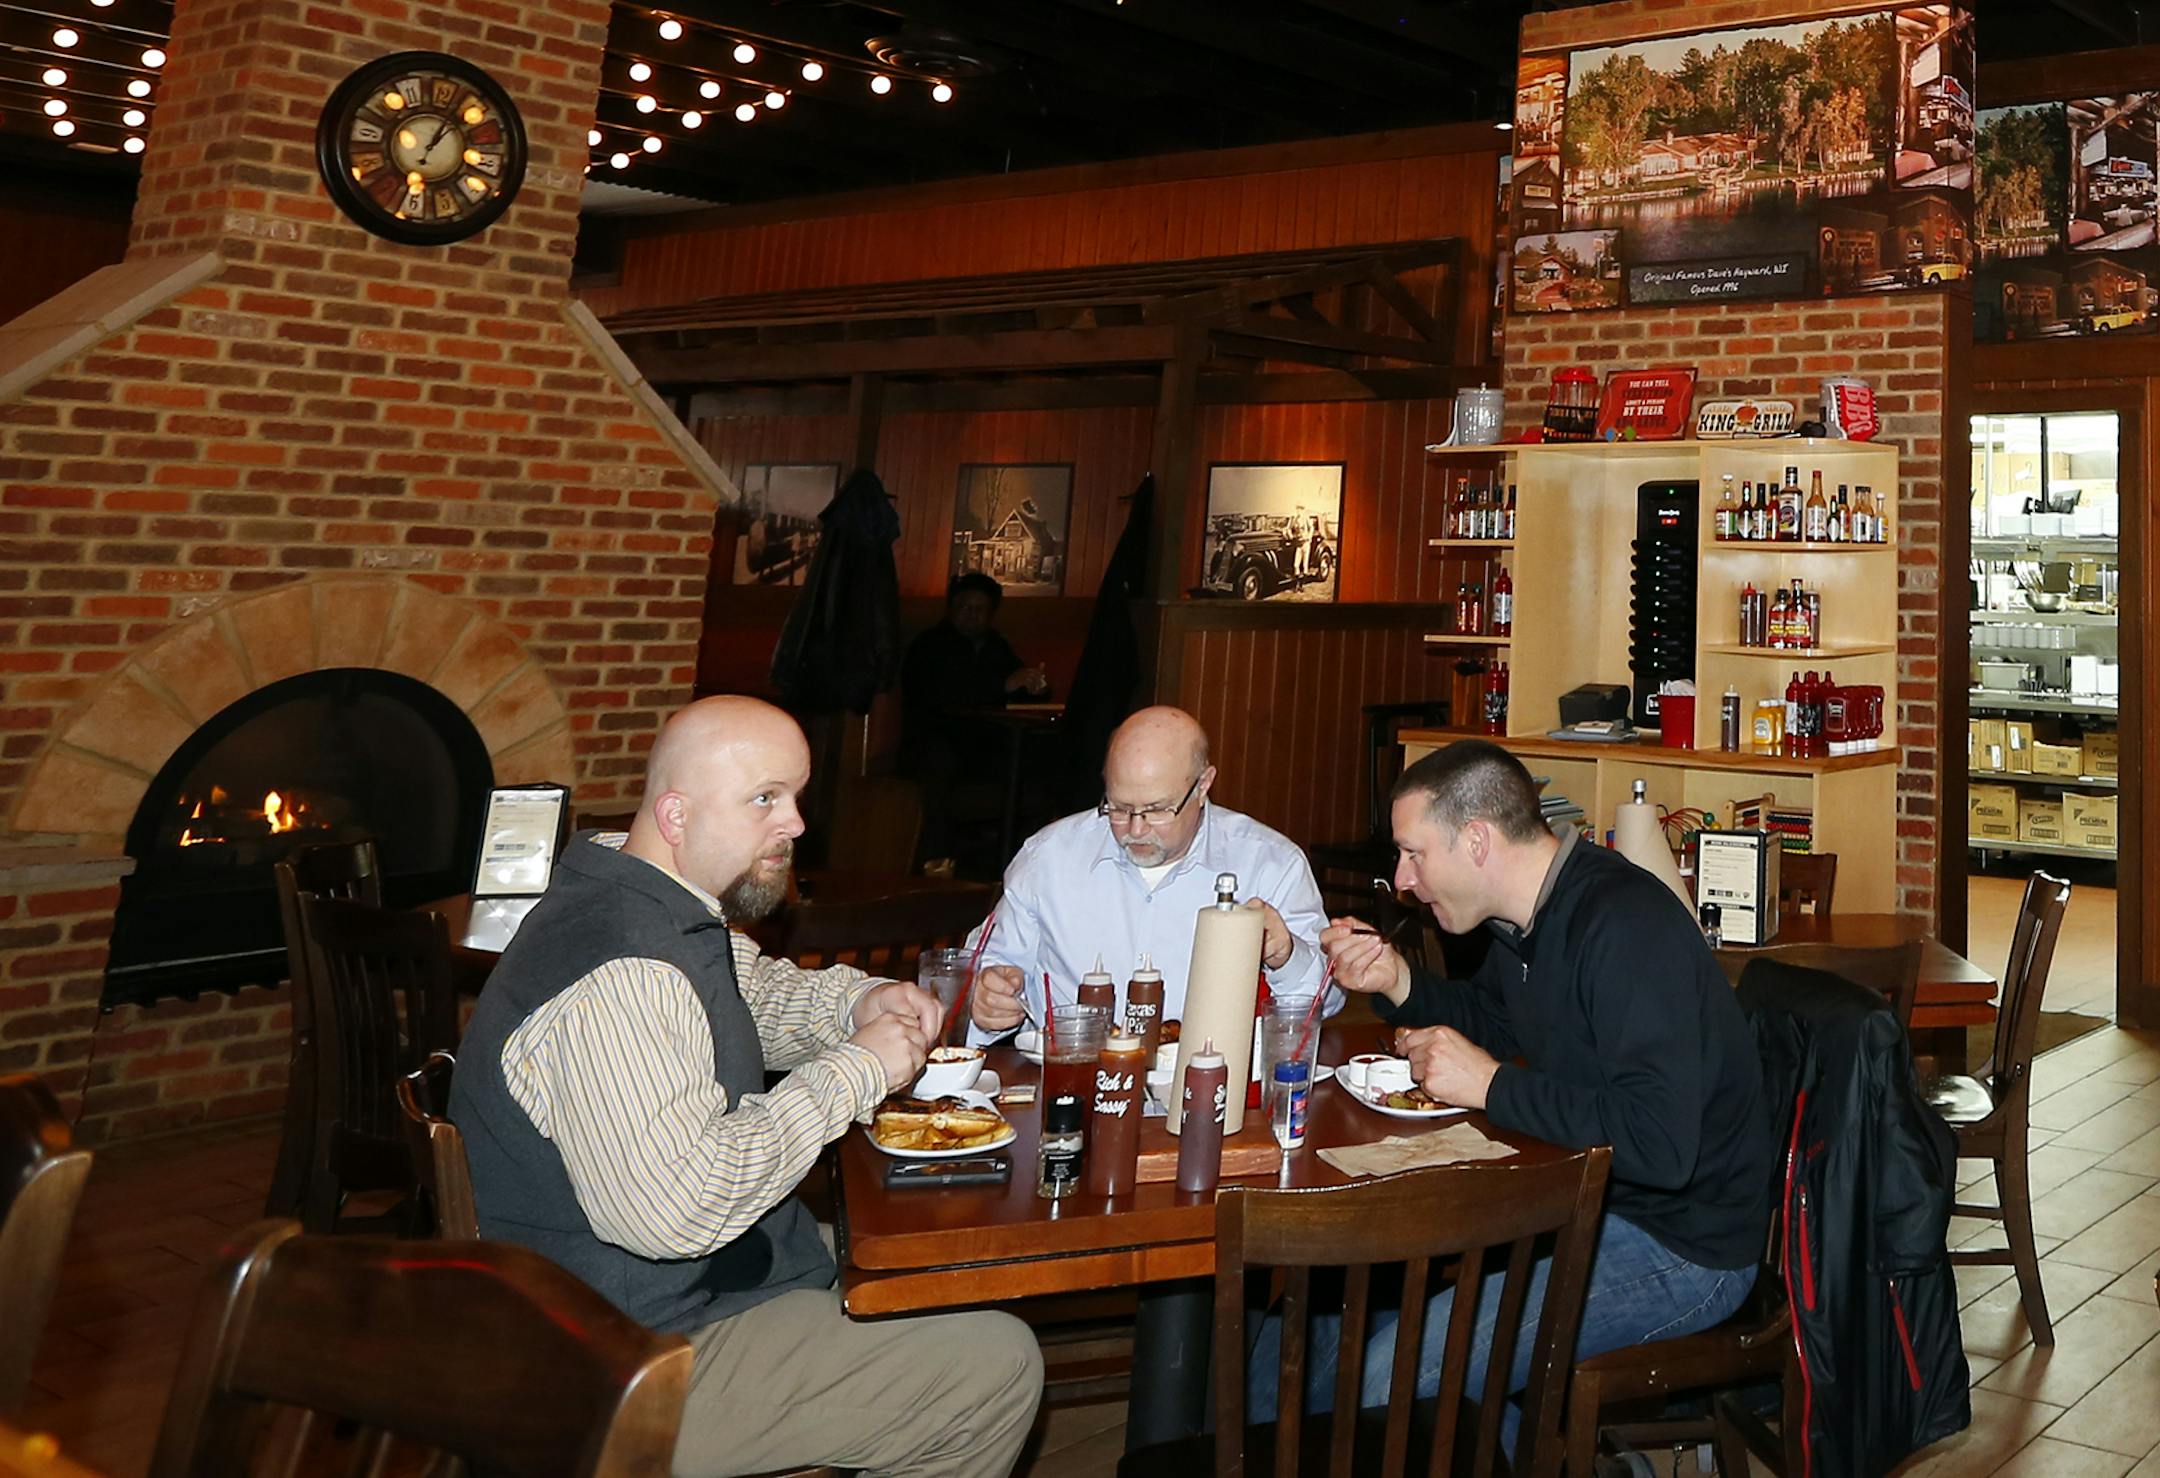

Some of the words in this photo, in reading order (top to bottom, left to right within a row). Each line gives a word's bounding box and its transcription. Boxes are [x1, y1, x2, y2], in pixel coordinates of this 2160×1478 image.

[405, 86, 416, 104] 11
[437, 86, 451, 105] 12
[438, 192, 450, 210] 5
[1644, 271, 1674, 284] Original
[1676, 269, 1705, 280] Famous
[1707, 268, 1732, 279] Dave's
[1734, 266, 1772, 279] Hayward,
[1774, 263, 1790, 274] WI
[1690, 284, 1721, 296] Opened
[1722, 282, 1739, 292] 1996
[1630, 380, 1641, 388] YOU
[1642, 380, 1653, 388] CAN
[1622, 406, 1635, 416] BY
[1637, 405, 1664, 416] THEIR
[1846, 386, 1874, 435] BBQ
[1698, 414, 1735, 431] KING
[1754, 412, 1793, 431] GRILL
[1096, 1070, 1122, 1092] Rich
[1122, 1074, 1134, 1091] &
[1094, 1092, 1131, 1118] Sassy
